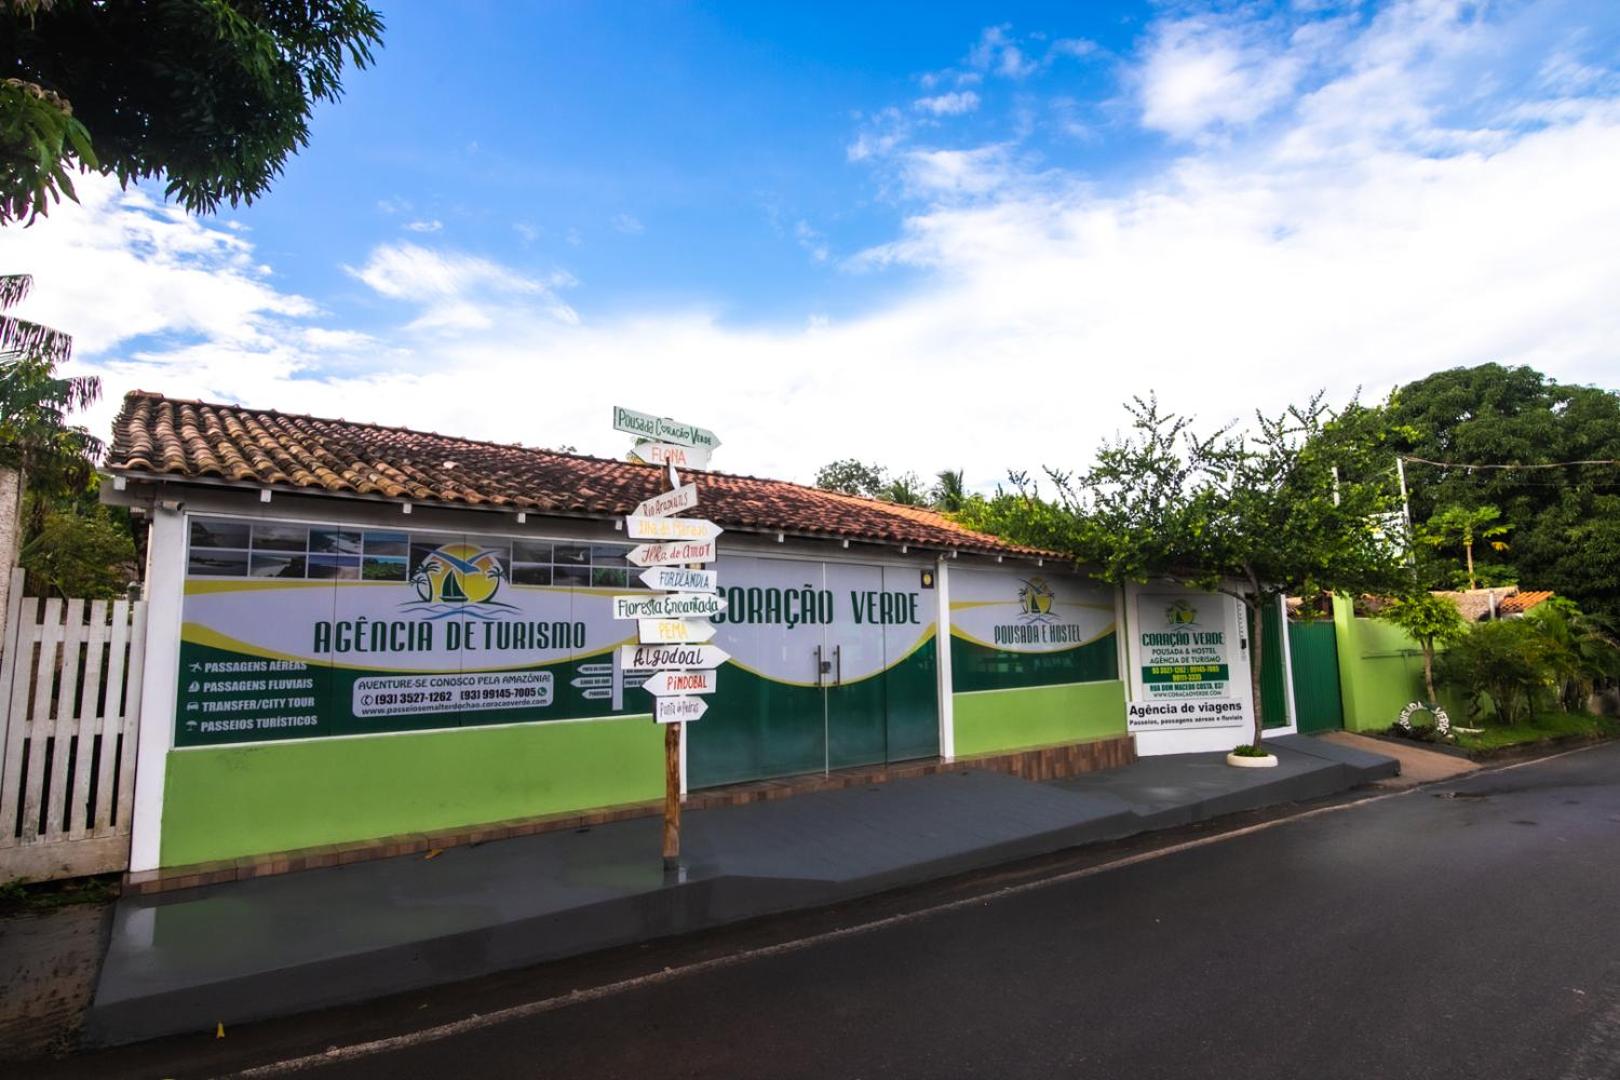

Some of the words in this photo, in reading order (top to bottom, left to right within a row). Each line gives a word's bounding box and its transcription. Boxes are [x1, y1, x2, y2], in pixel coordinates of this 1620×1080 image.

[618, 598, 662, 618] Floresta
[664, 596, 718, 614] Encantada
[709, 584, 834, 629] CORAÇÃO
[851, 590, 921, 624] VERDE
[314, 616, 433, 653] AGÊNCIA
[446, 622, 477, 650] DE
[482, 621, 586, 650] TURISMO
[994, 624, 1040, 644] POUSADA
[1042, 626, 1048, 643] E
[1050, 624, 1082, 642] HOSTEL
[1142, 632, 1190, 647] CORAÇÃO
[1192, 632, 1224, 645] VERDE
[633, 648, 704, 668] Algodoal
[1152, 648, 1184, 656] POUSADA
[204, 661, 268, 673] PASSAGENS
[203, 682, 267, 694] PASSAGENS
[268, 678, 313, 690] FLUVIAIS
[430, 676, 475, 688] CONOSCO
[478, 674, 500, 685] PELA
[400, 691, 452, 704] 3527-1262
[482, 687, 537, 700] 99145-7005
[202, 699, 286, 712] TRANSFER/CITY
[288, 696, 315, 708] TOUR
[1129, 704, 1177, 718] Agência
[1181, 703, 1195, 713] de
[1198, 702, 1242, 714] viagens
[201, 720, 254, 732] PASSEIOS
[256, 716, 318, 729] TURÍSTICOS
